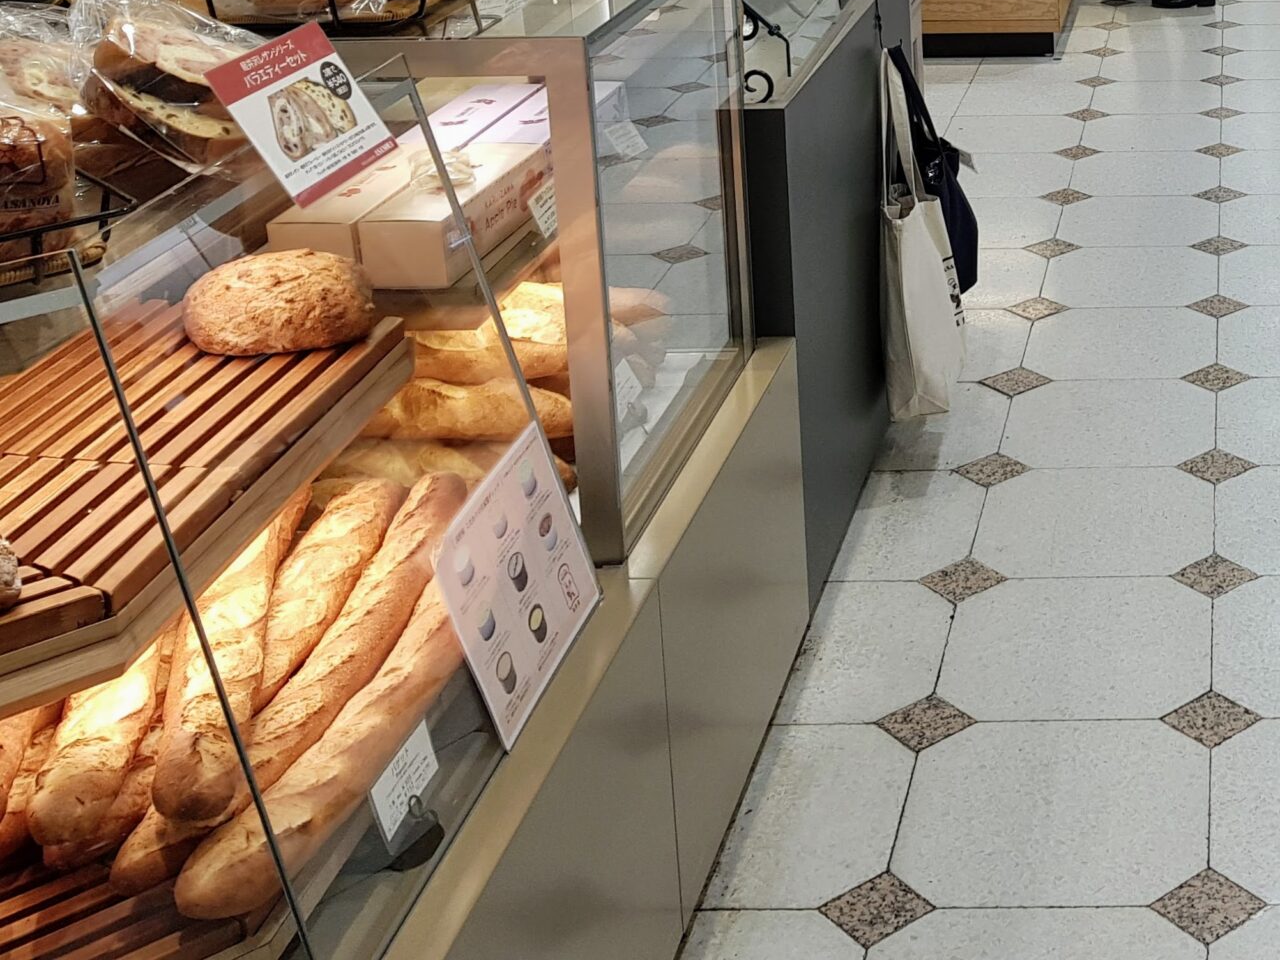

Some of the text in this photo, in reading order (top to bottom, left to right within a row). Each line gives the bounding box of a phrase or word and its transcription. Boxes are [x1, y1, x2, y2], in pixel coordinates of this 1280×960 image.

[244, 50, 307, 88] バラエティーセット
